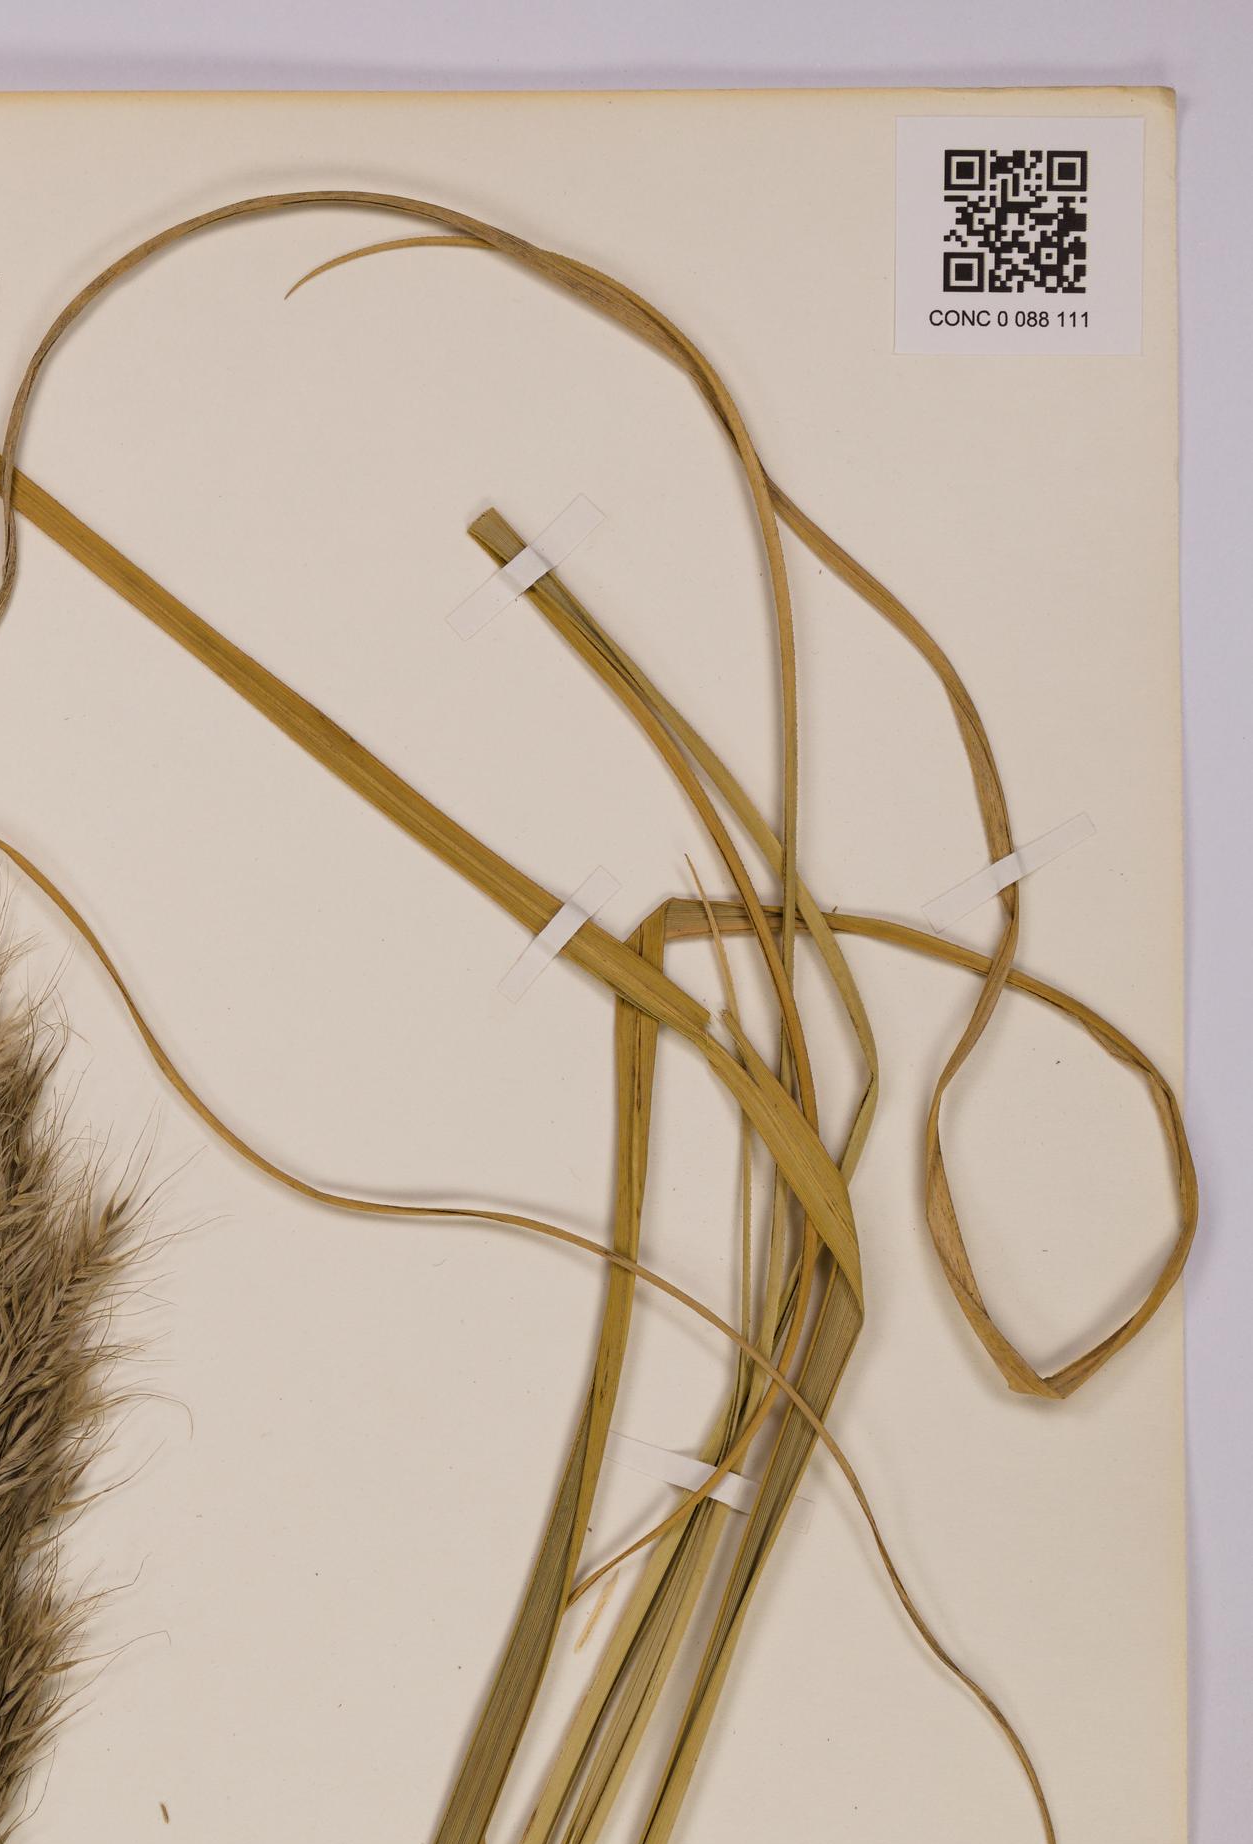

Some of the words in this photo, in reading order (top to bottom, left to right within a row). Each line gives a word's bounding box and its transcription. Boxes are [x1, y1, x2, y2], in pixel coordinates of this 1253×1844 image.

[930, 310, 990, 326] CONC
[998, 311, 1008, 326] 0
[1015, 311, 1049, 327] 088
[1058, 312, 1087, 327] 111
